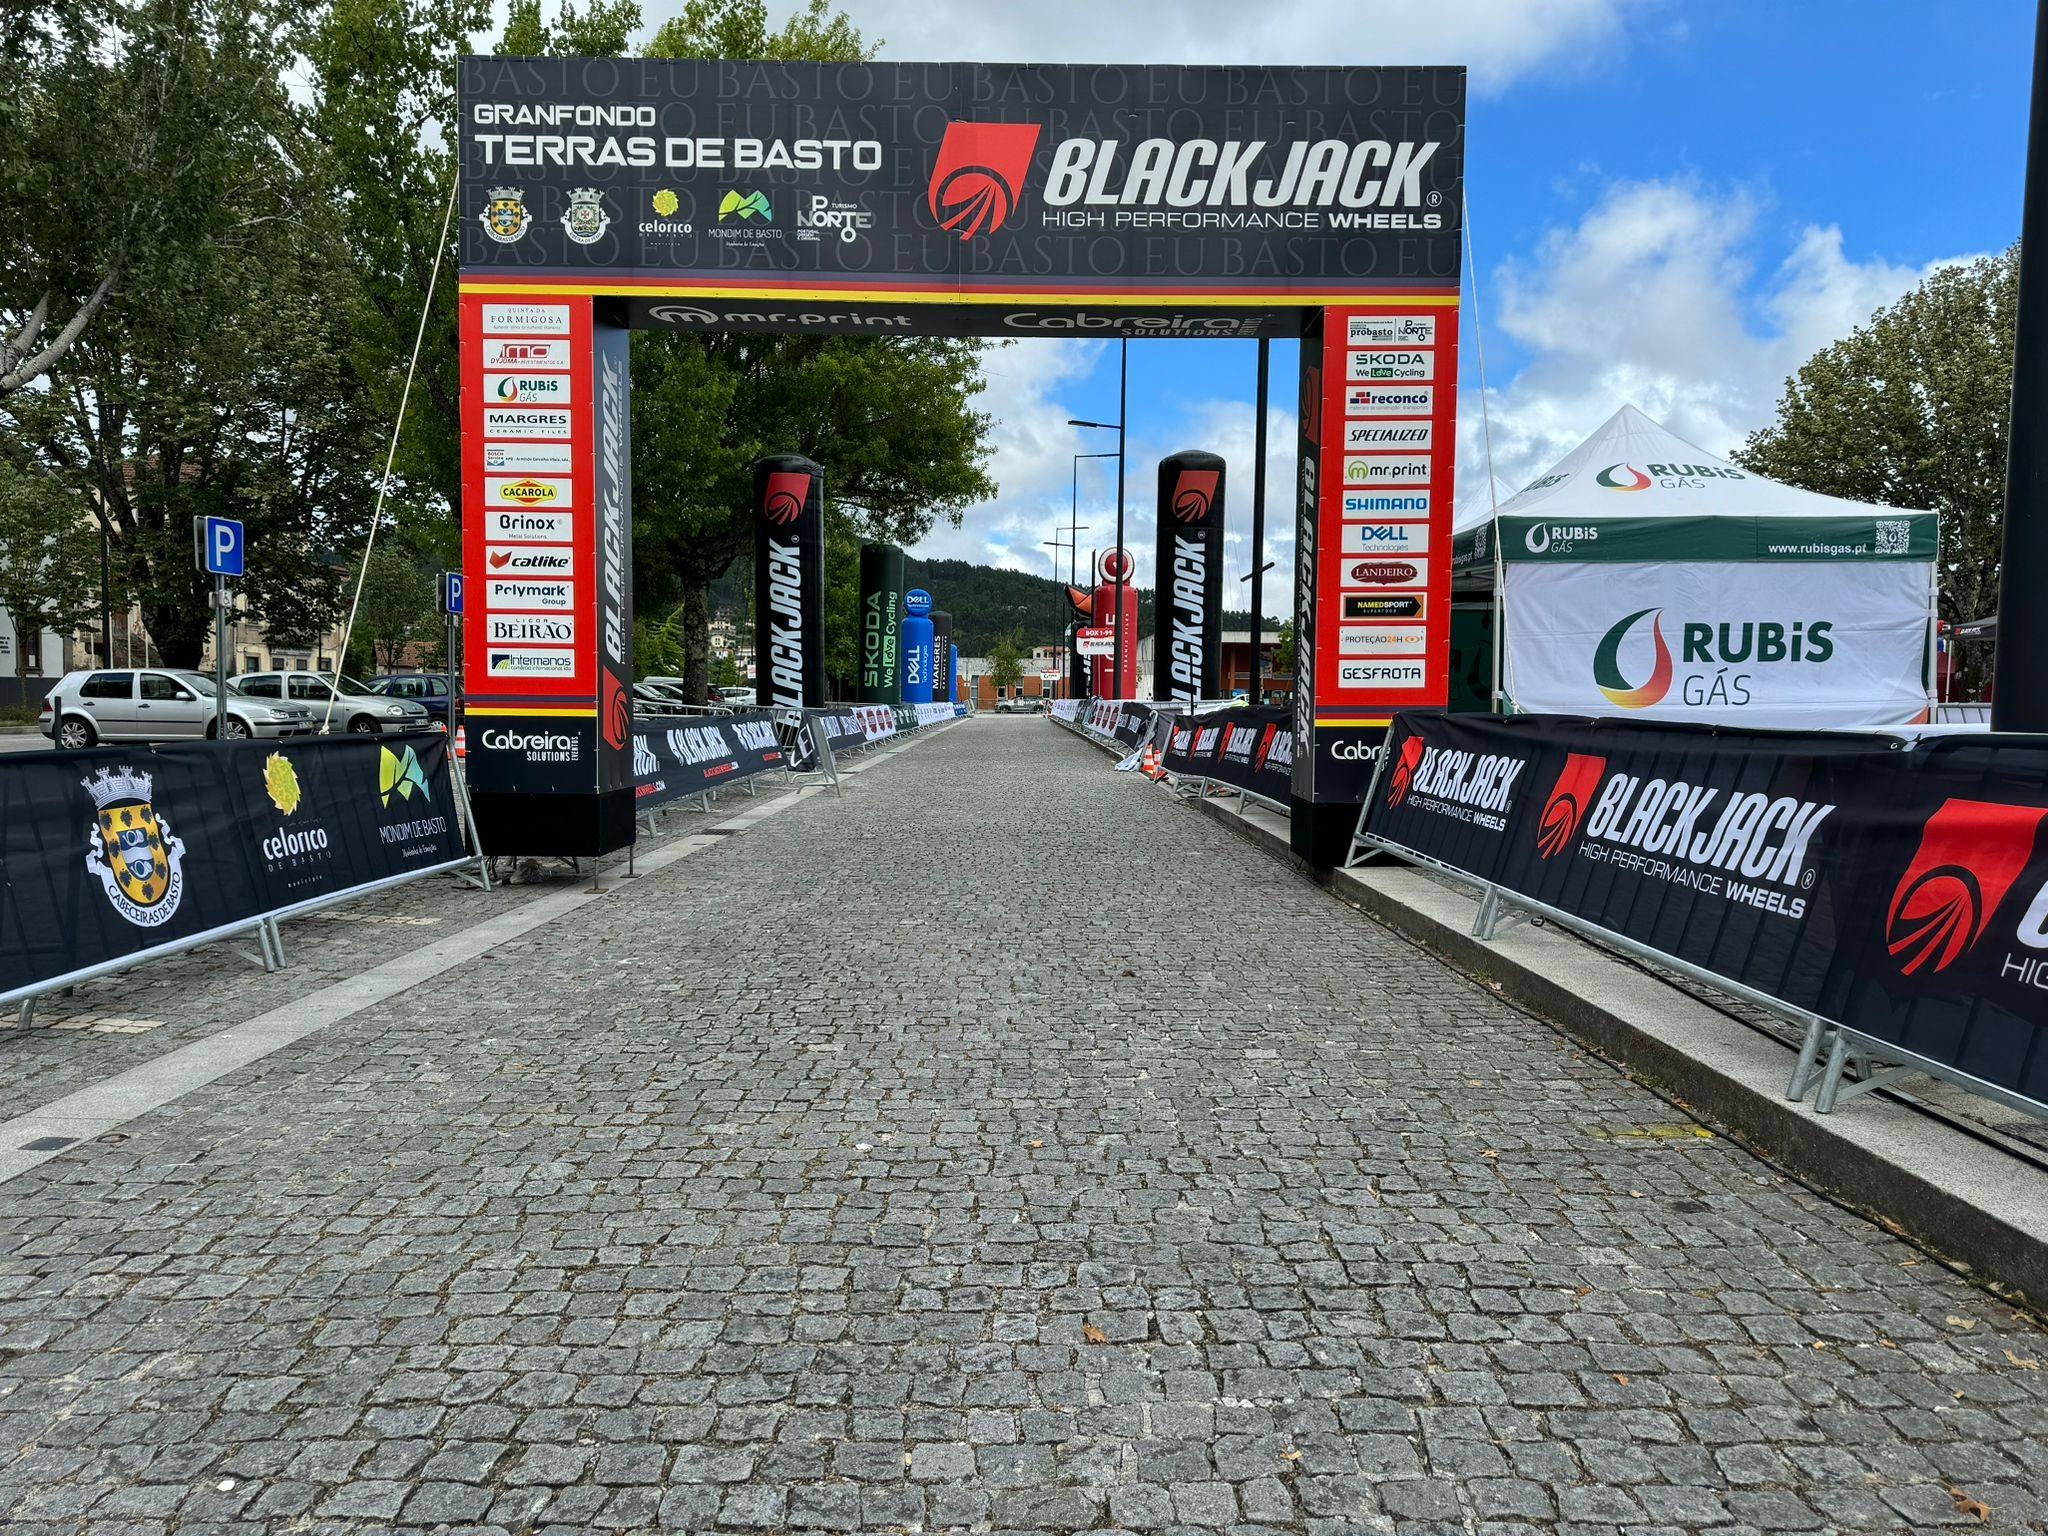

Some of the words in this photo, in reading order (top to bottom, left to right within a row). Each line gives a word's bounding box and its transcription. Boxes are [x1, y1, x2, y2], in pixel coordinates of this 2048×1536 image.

[473, 104, 656, 127] GRANFONDO
[474, 135, 655, 167] TERRAS
[665, 137, 726, 168] DE
[734, 138, 882, 171] BASTO
[1042, 138, 1441, 208] BLACKJACK
[638, 220, 692, 233] celorico
[1042, 211, 1105, 228] HIGH
[1115, 211, 1320, 229] PERFORMANCE
[1328, 213, 1442, 230] WHEELS
[708, 229, 741, 239] MONDIM
[743, 229, 753, 239] DE
[755, 229, 783, 239] BASTO
[491, 315, 562, 324] FORMIGOSA
[1003, 313, 1240, 329] Cabreira
[1121, 328, 1234, 336] SOLUTIONS
[1356, 369, 1369, 377] We
[1394, 368, 1425, 377] Cycling
[519, 392, 538, 402] GÁS
[1372, 395, 1428, 404] reconco
[489, 414, 567, 424] MARGRES
[1348, 429, 1429, 442] SPECIALIZED
[1660, 477, 1705, 489] GÁS
[602, 349, 621, 664] BLACKJACK
[1345, 498, 1427, 510] SHIMANO
[500, 514, 555, 530] Brinox
[1362, 526, 1408, 541] DELL
[215, 525, 235, 566] P
[1362, 544, 1408, 552] Technologies
[1551, 540, 1573, 553] GÁS
[1768, 543, 1867, 556] www.rubisgas.pt
[511, 556, 569, 568] catlike
[1356, 568, 1413, 577] LANDEIRO
[450, 578, 461, 608] P
[495, 584, 565, 597] Polymark
[542, 598, 566, 606] Group
[907, 596, 929, 604] DELL
[1299, 456, 1315, 758] BLACKJACK
[886, 592, 898, 635] Cycling
[1171, 534, 1206, 702] LACKJACK
[494, 622, 572, 639] BEIRÃO
[908, 645, 920, 684] DELL
[933, 635, 941, 689] MARGRES
[884, 668, 894, 688] We
[1342, 667, 1421, 680] GESFROTA
[1683, 667, 1751, 706] GÁS
[481, 729, 571, 750] Cabreira
[526, 751, 570, 761] SOLUTIONS
[1412, 746, 1525, 812] BLACKJACK
[1407, 794, 1422, 808] HIGH
[1422, 797, 1473, 822] PERFORMANCE
[1473, 811, 1506, 832] WHEELS
[379, 823, 413, 844] MONDIM
[412, 820, 423, 838] DE
[422, 817, 447, 836] BASTO
[1586, 773, 1837, 886] BLACKJACK
[263, 827, 328, 860] celorico
[268, 861, 284, 873] DE
[292, 850, 332, 867] BASTO
[1579, 841, 1610, 863] HIGH
[1610, 849, 1723, 895] PERFORMANCE
[1725, 880, 1806, 920] WHEELS
[108, 885, 159, 924] CABECEIRAS
[158, 903, 170, 919] DE
[168, 872, 181, 910] BASTO
